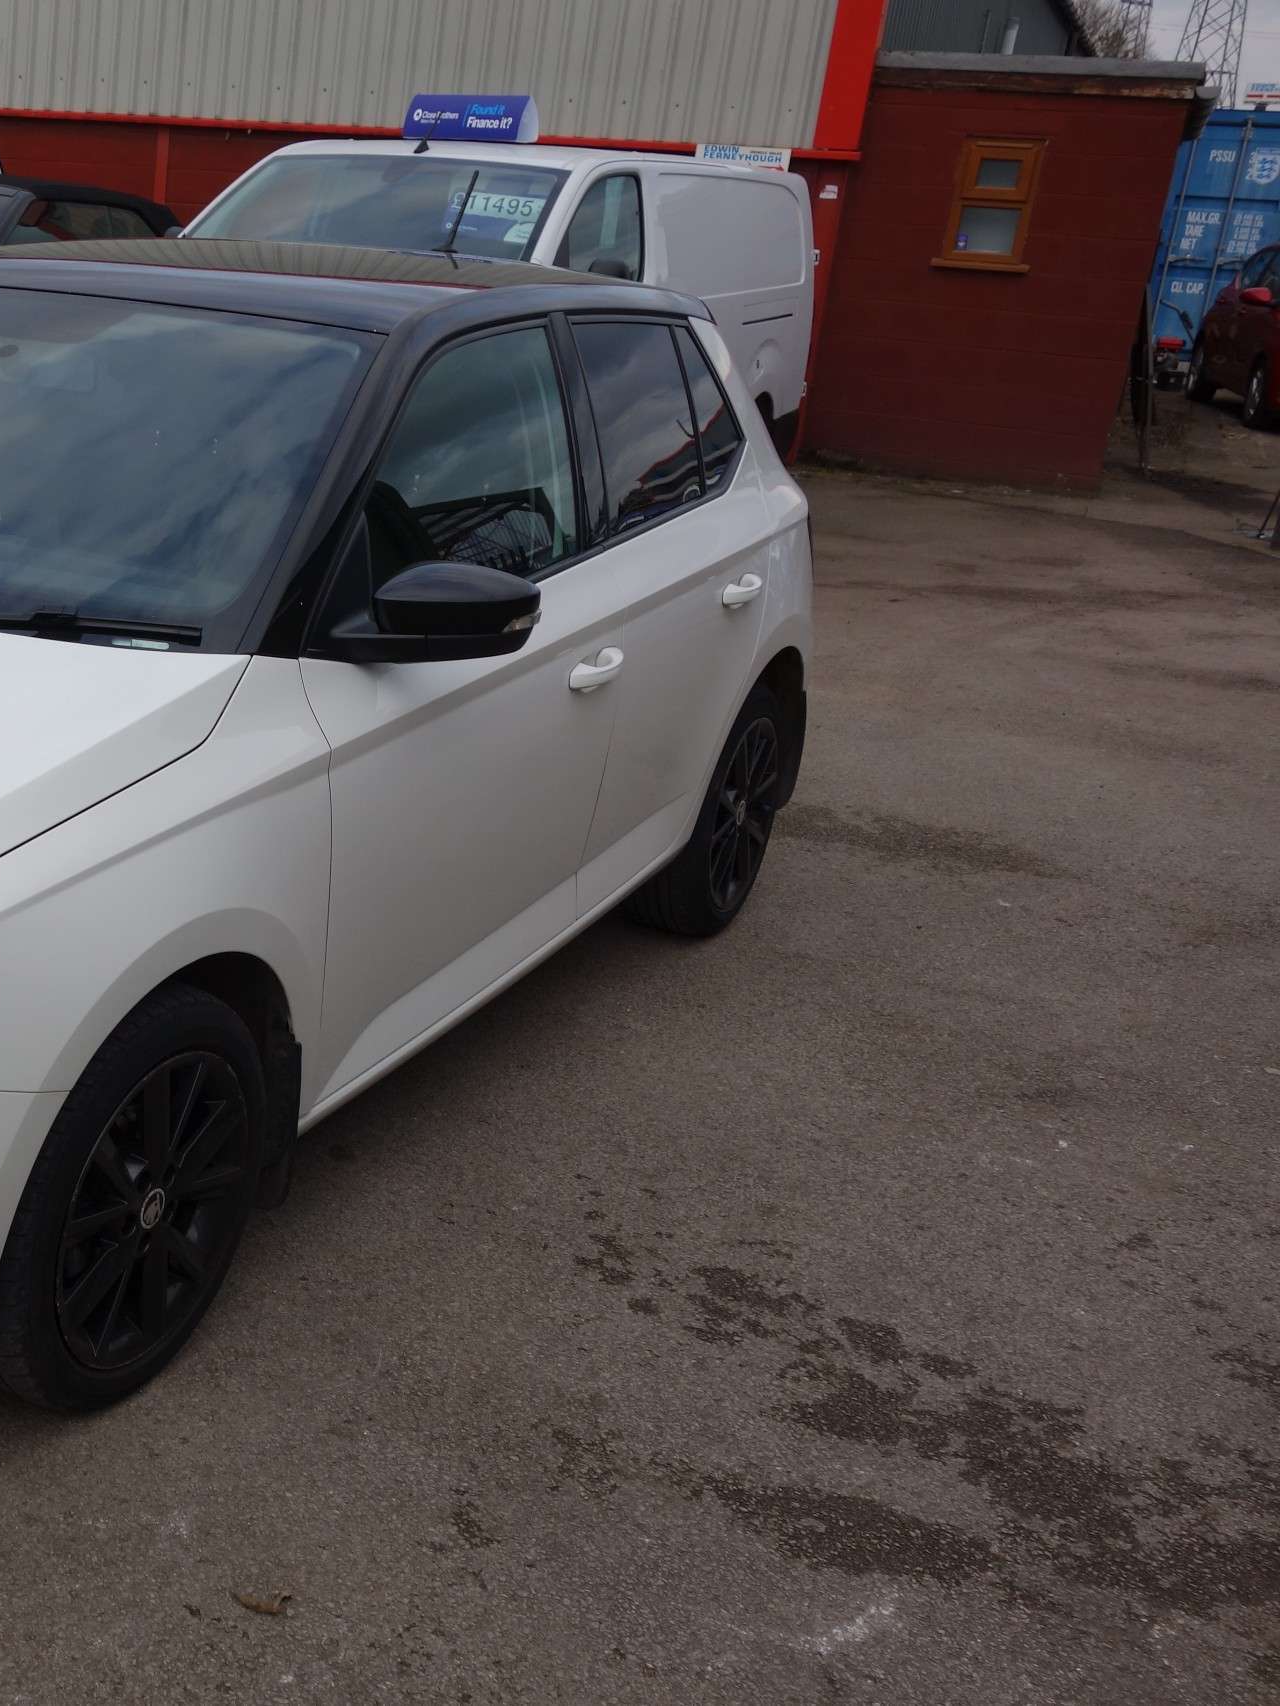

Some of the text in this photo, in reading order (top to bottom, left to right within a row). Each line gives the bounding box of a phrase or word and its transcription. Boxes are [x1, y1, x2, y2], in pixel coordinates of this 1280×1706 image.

[470, 104, 505, 115] Found it
[466, 116, 513, 128] Finance it?
[704, 144, 740, 154] EDWIN
[703, 151, 783, 162] FERNEYHOUGH
[1210, 150, 1236, 162] PSSU
